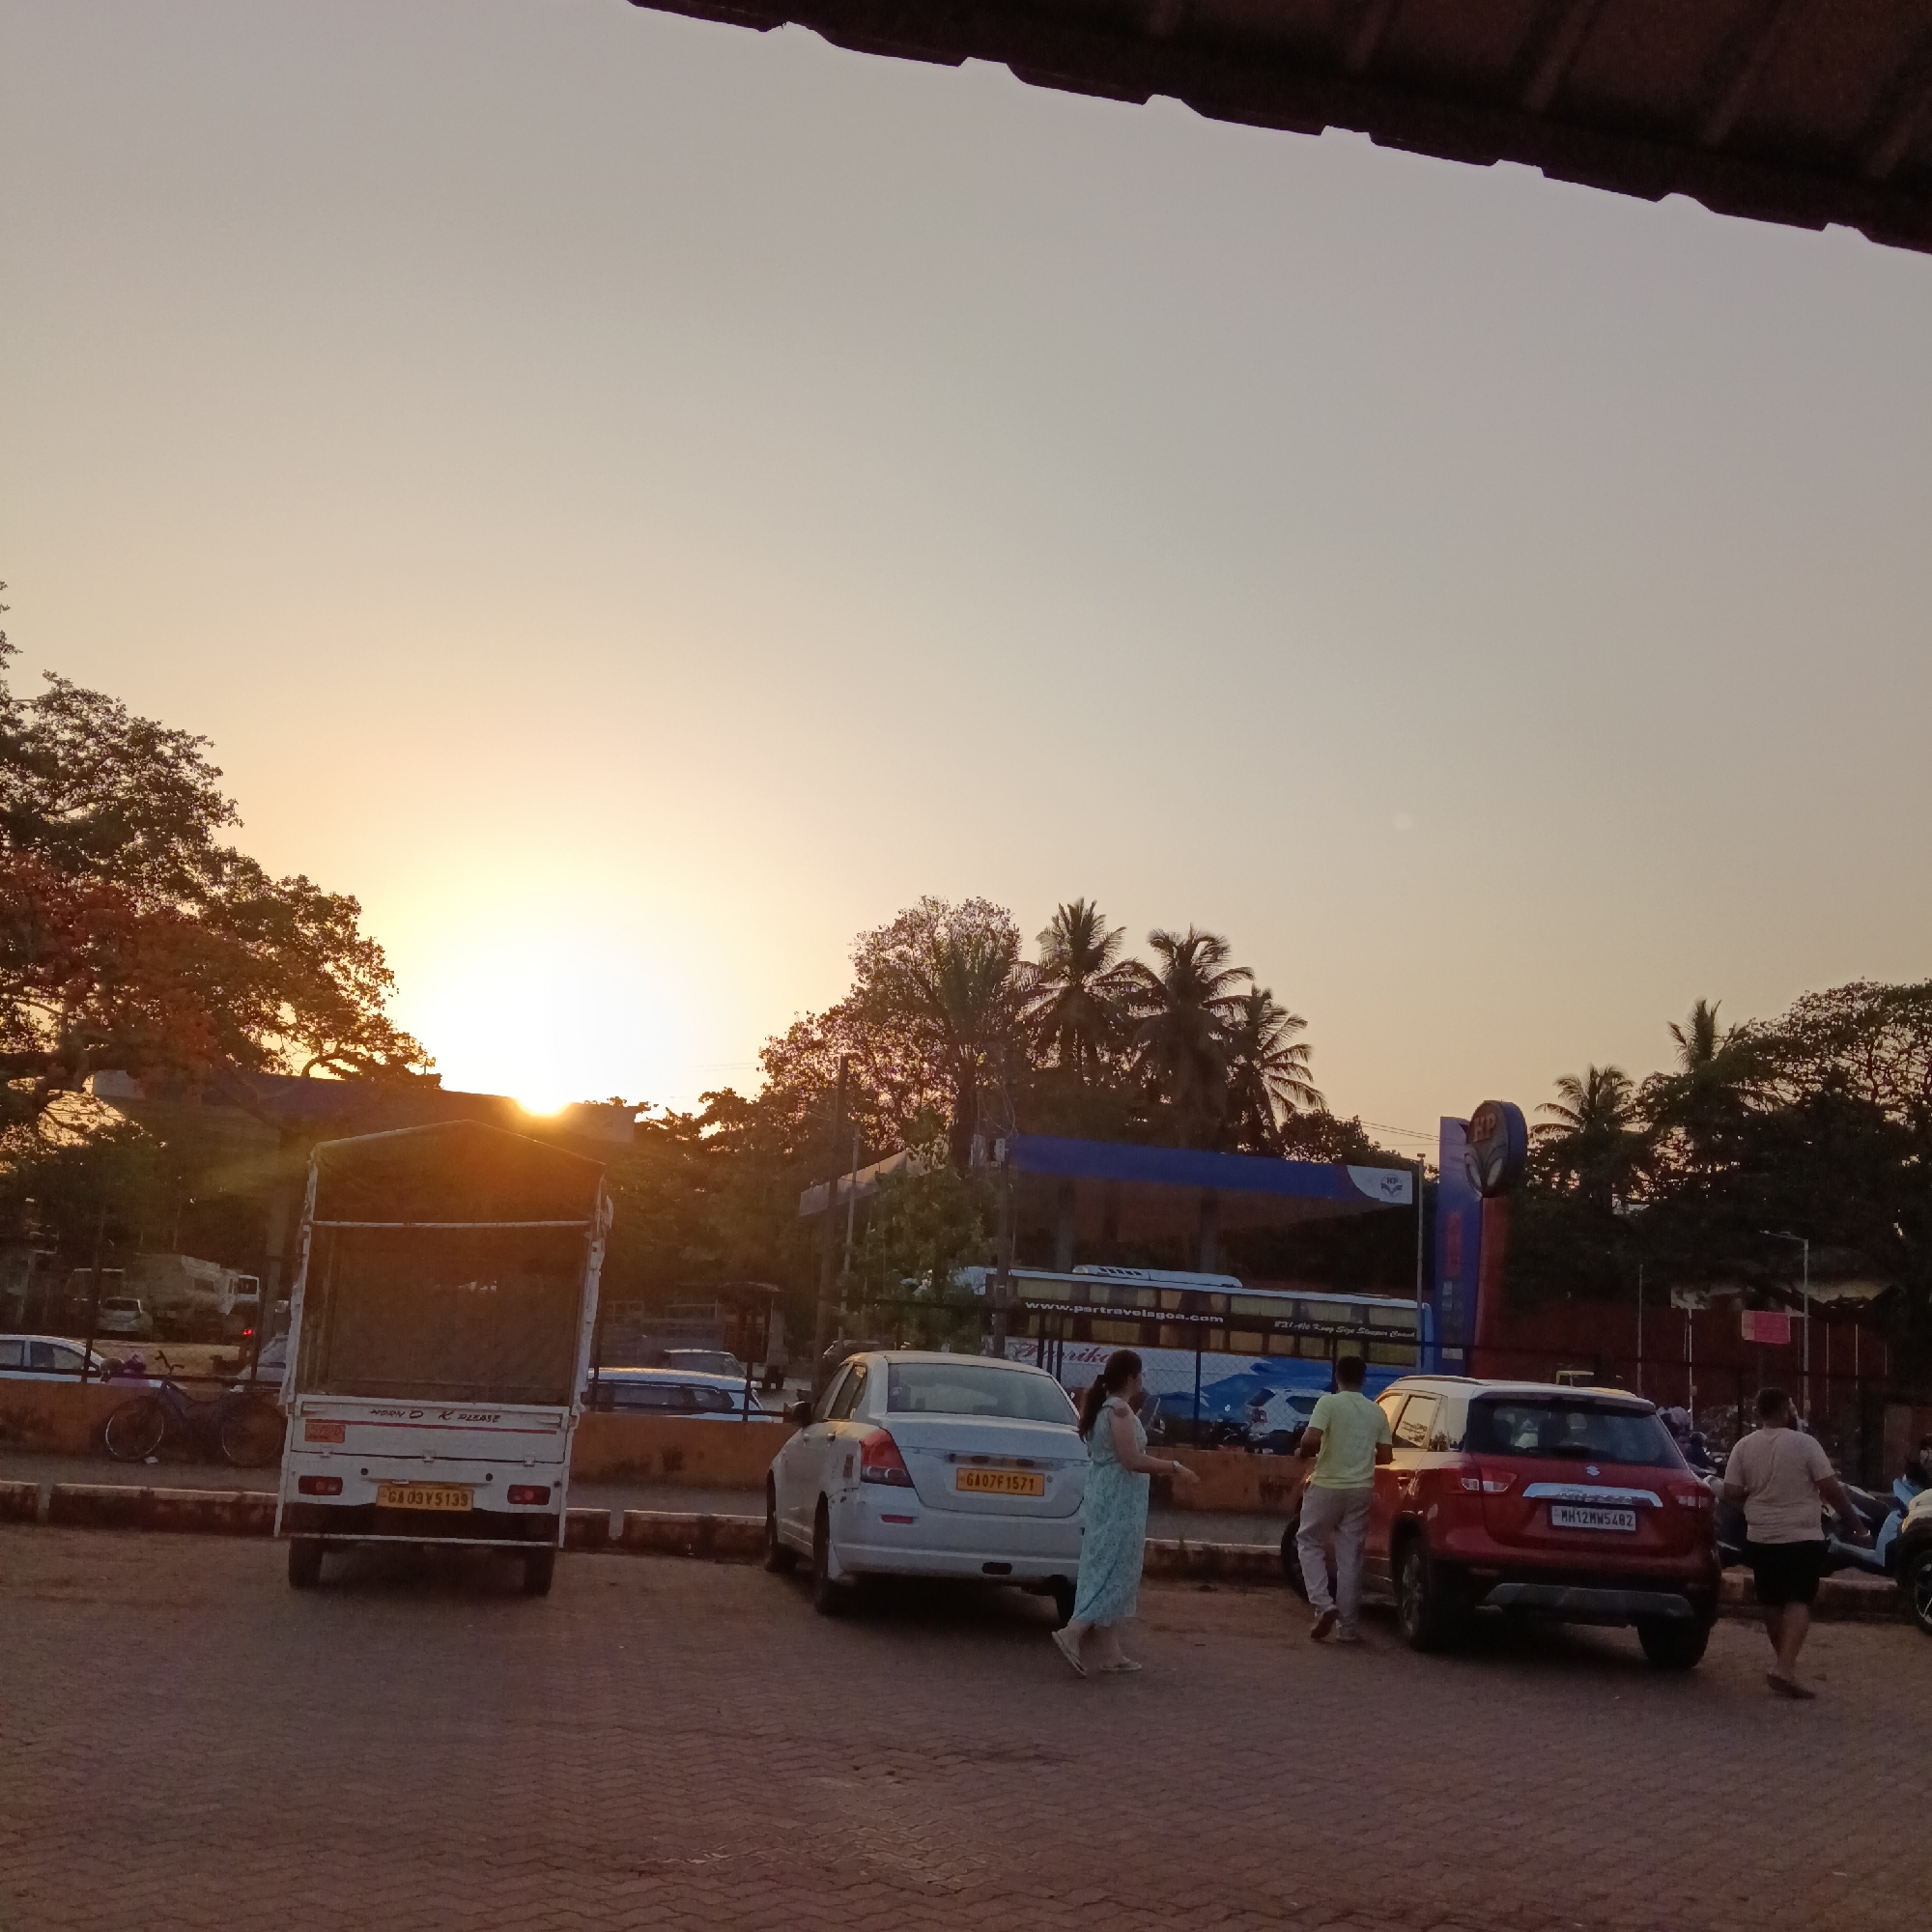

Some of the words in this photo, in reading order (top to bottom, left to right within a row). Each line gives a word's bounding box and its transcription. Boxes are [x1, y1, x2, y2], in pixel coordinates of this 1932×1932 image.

[1473, 1113, 1496, 1143] HP
[409, 1410, 424, 1419] O
[438, 1410, 455, 1421] K
[457, 1413, 501, 1423] PLEASE
